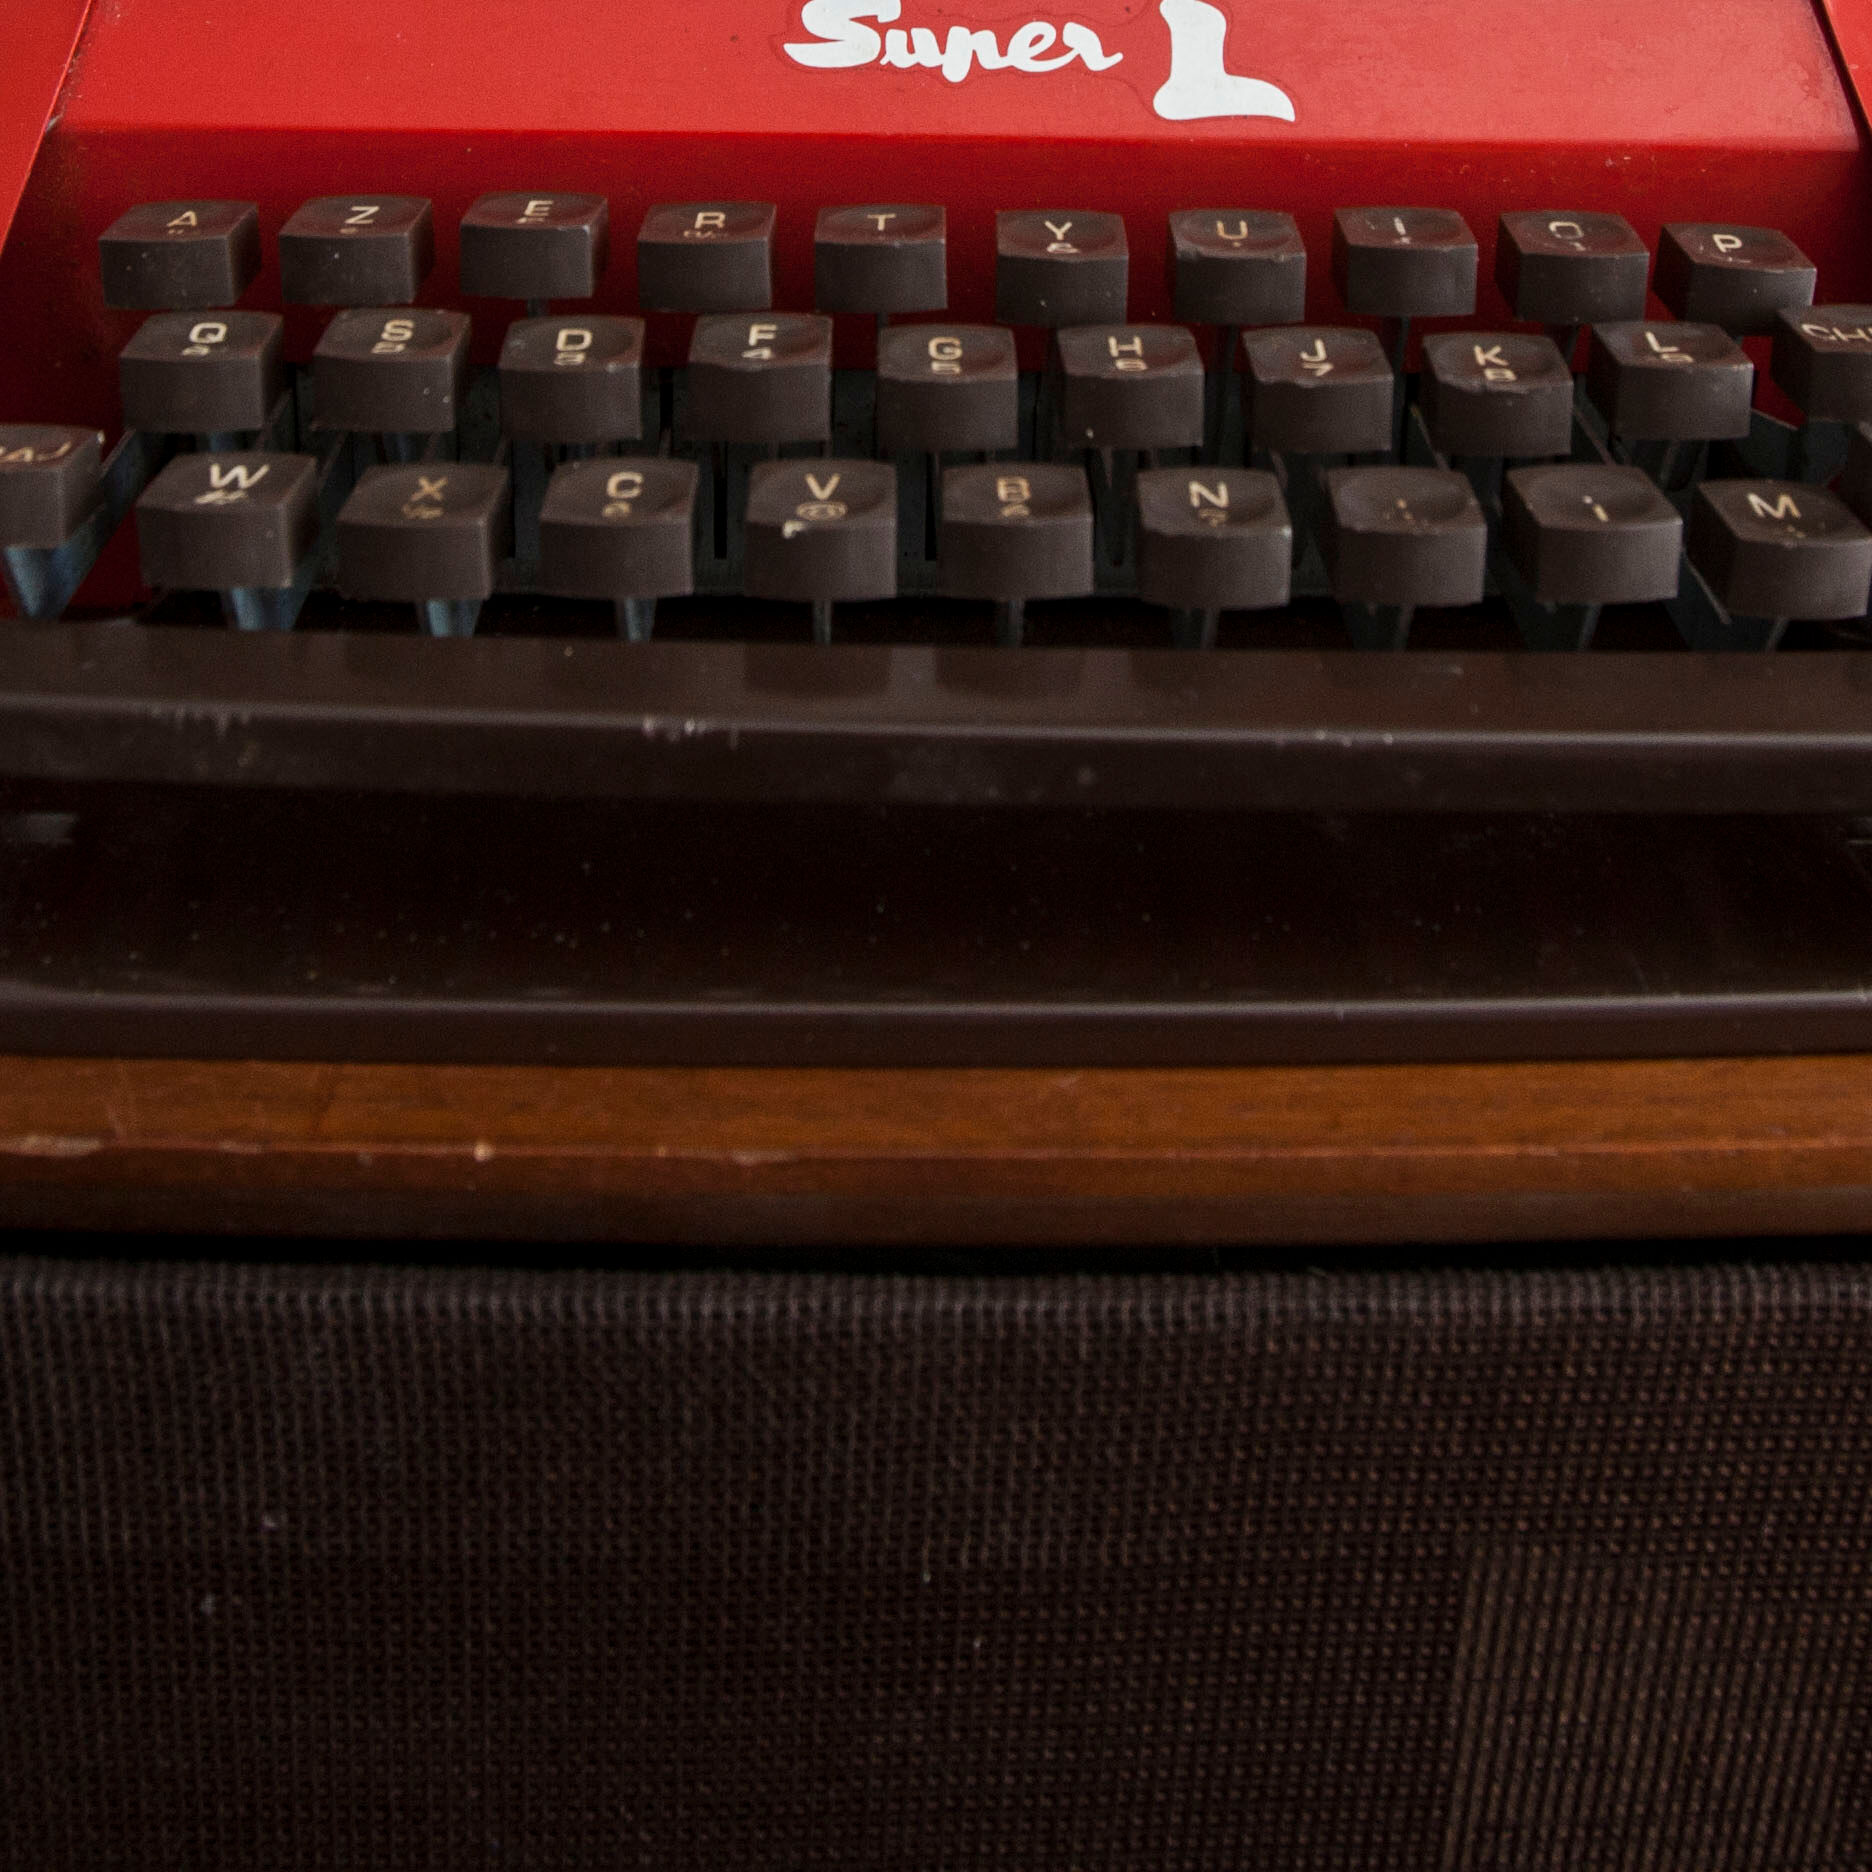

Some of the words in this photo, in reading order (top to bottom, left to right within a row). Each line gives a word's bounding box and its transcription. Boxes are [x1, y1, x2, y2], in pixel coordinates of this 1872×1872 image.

[167, 210, 197, 228] A
[343, 205, 381, 225] Z
[523, 199, 555, 218] E
[693, 211, 727, 230] R
[866, 213, 897, 232] T
[1043, 221, 1073, 241] Y
[1215, 219, 1249, 240] U
[1711, 233, 1743, 253] P
[188, 321, 228, 345] Q
[380, 319, 415, 342] S
[555, 329, 593, 351] D
[747, 324, 778, 347] F
[1644, 330, 1681, 354] L
[927, 336, 964, 361] G
[1108, 335, 1144, 358] H
[1299, 338, 1328, 362] J
[1473, 344, 1509, 367] K
[209, 463, 270, 489] W
[605, 471, 643, 500] C
[804, 473, 841, 501] V
[409, 477, 449, 502] X
[1188, 480, 1229, 508] N
[1746, 492, 1803, 520] M
